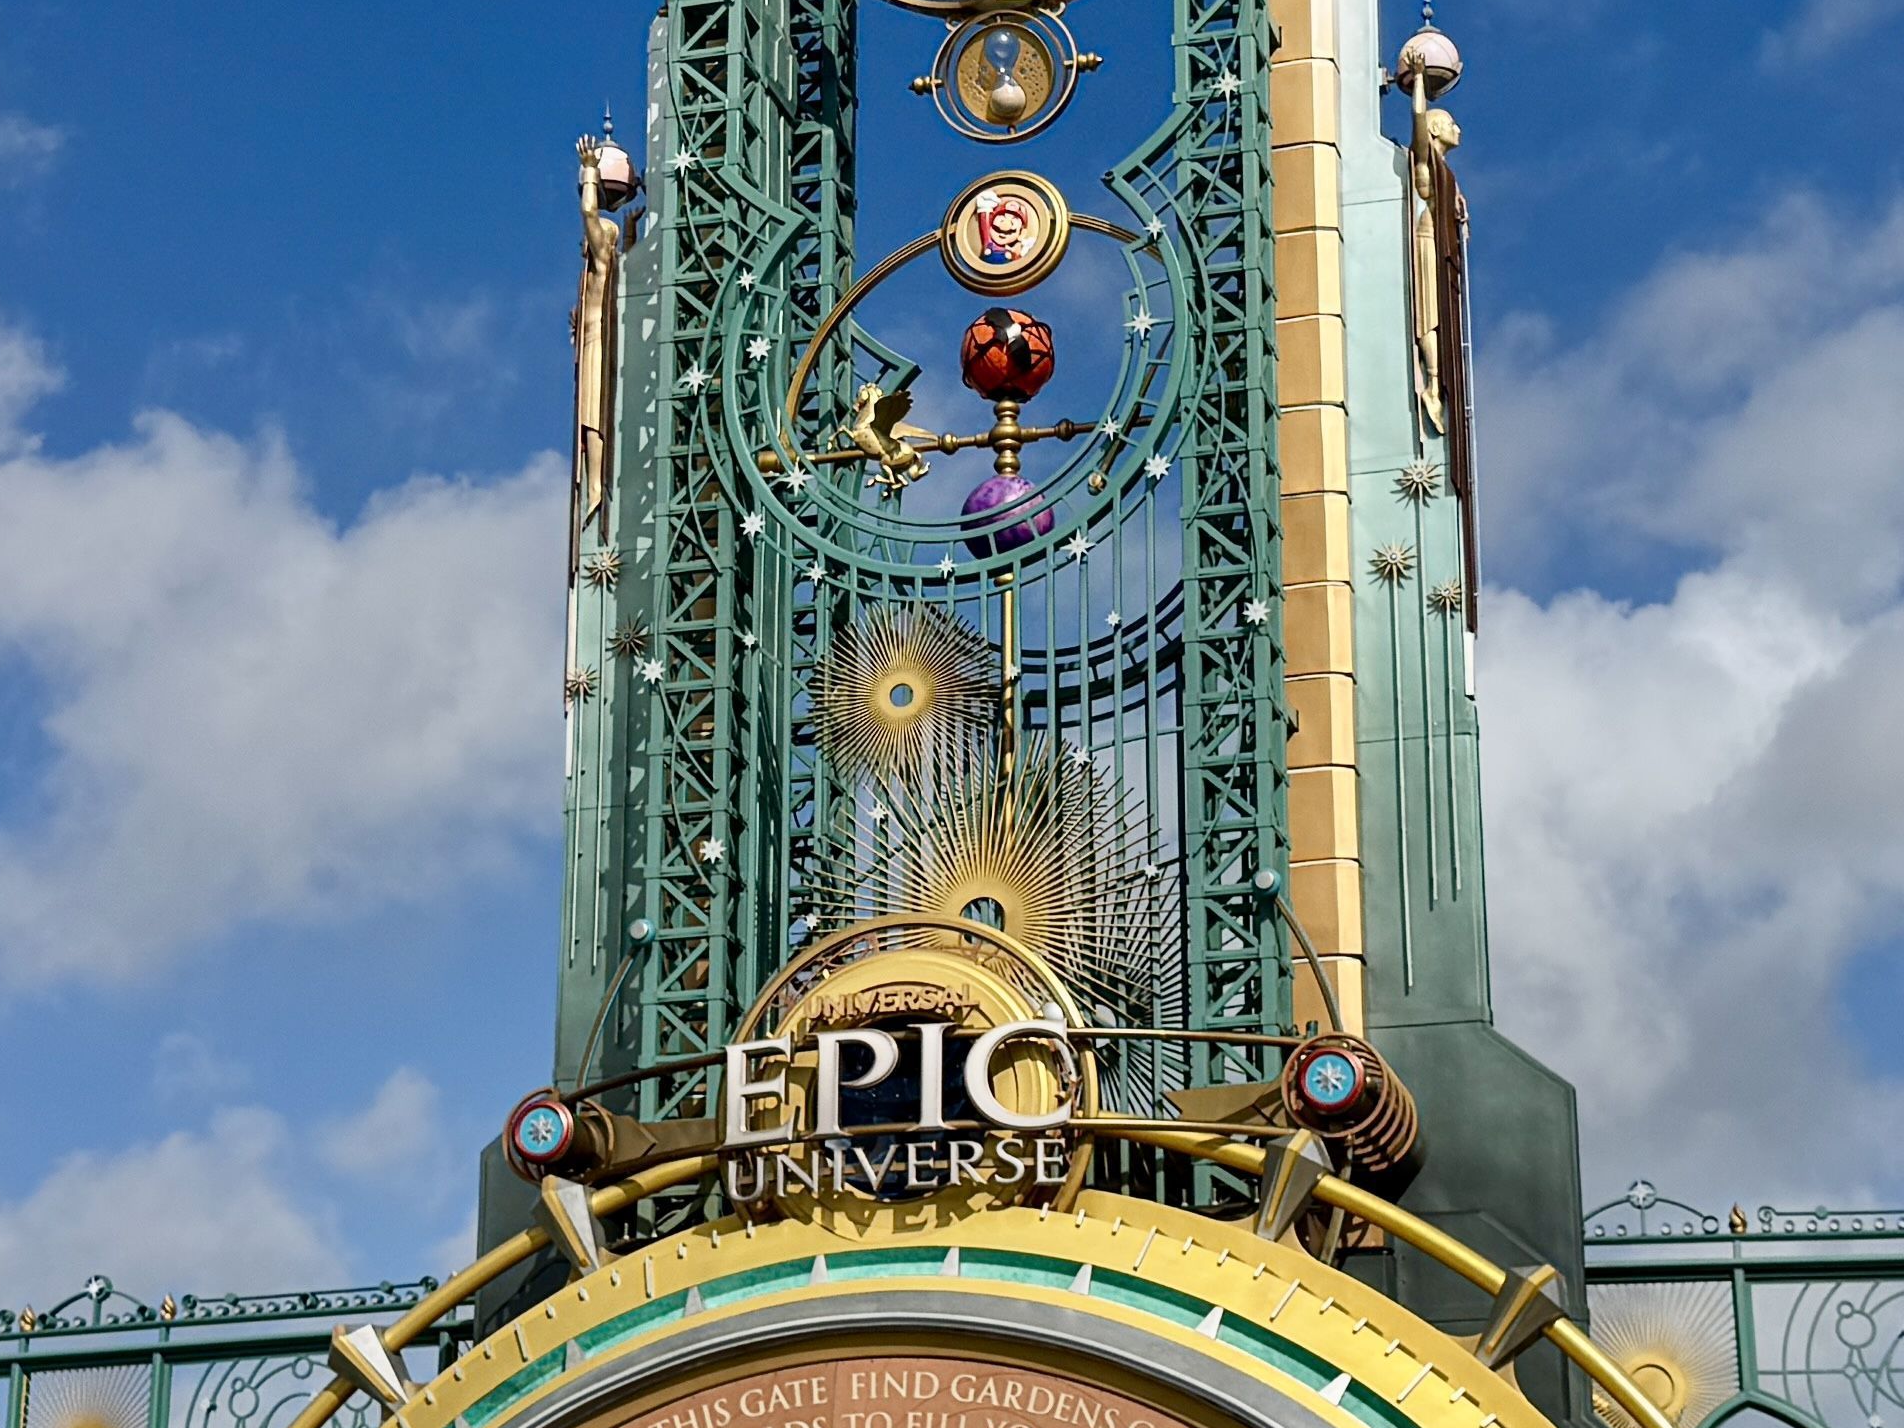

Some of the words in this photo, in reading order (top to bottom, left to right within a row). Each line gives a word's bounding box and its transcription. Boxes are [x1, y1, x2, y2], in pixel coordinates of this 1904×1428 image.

[804, 983, 980, 1018] UNIVERSAL
[725, 1019, 1073, 1149] EPIC
[727, 1138, 1069, 1202] UNIVERSE
[739, 1376, 828, 1419] GATE
[851, 1372, 939, 1400] FIND
